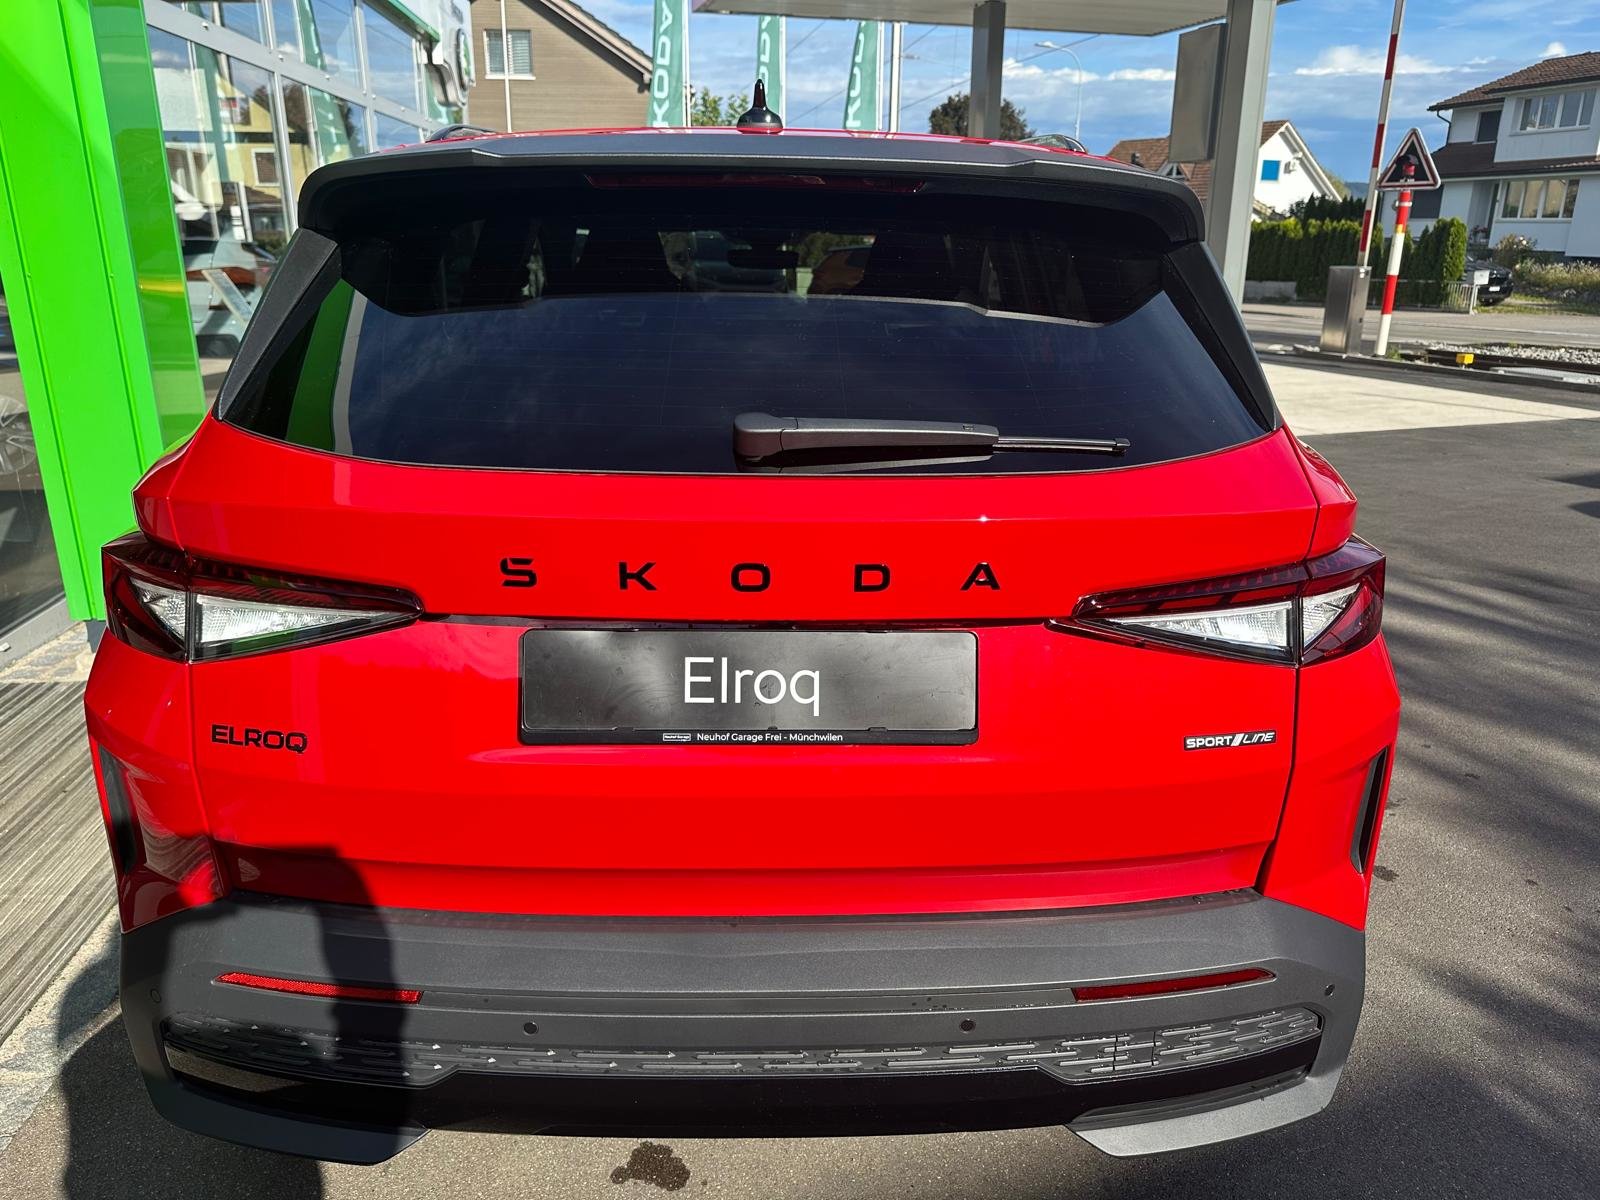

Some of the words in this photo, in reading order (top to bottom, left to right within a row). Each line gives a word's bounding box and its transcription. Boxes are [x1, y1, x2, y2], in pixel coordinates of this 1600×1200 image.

[684, 656, 819, 716] Elroq
[211, 724, 308, 754] ELROQ
[697, 732, 730, 742] Neuhof
[731, 733, 763, 743] Garage
[765, 733, 782, 742] Frei
